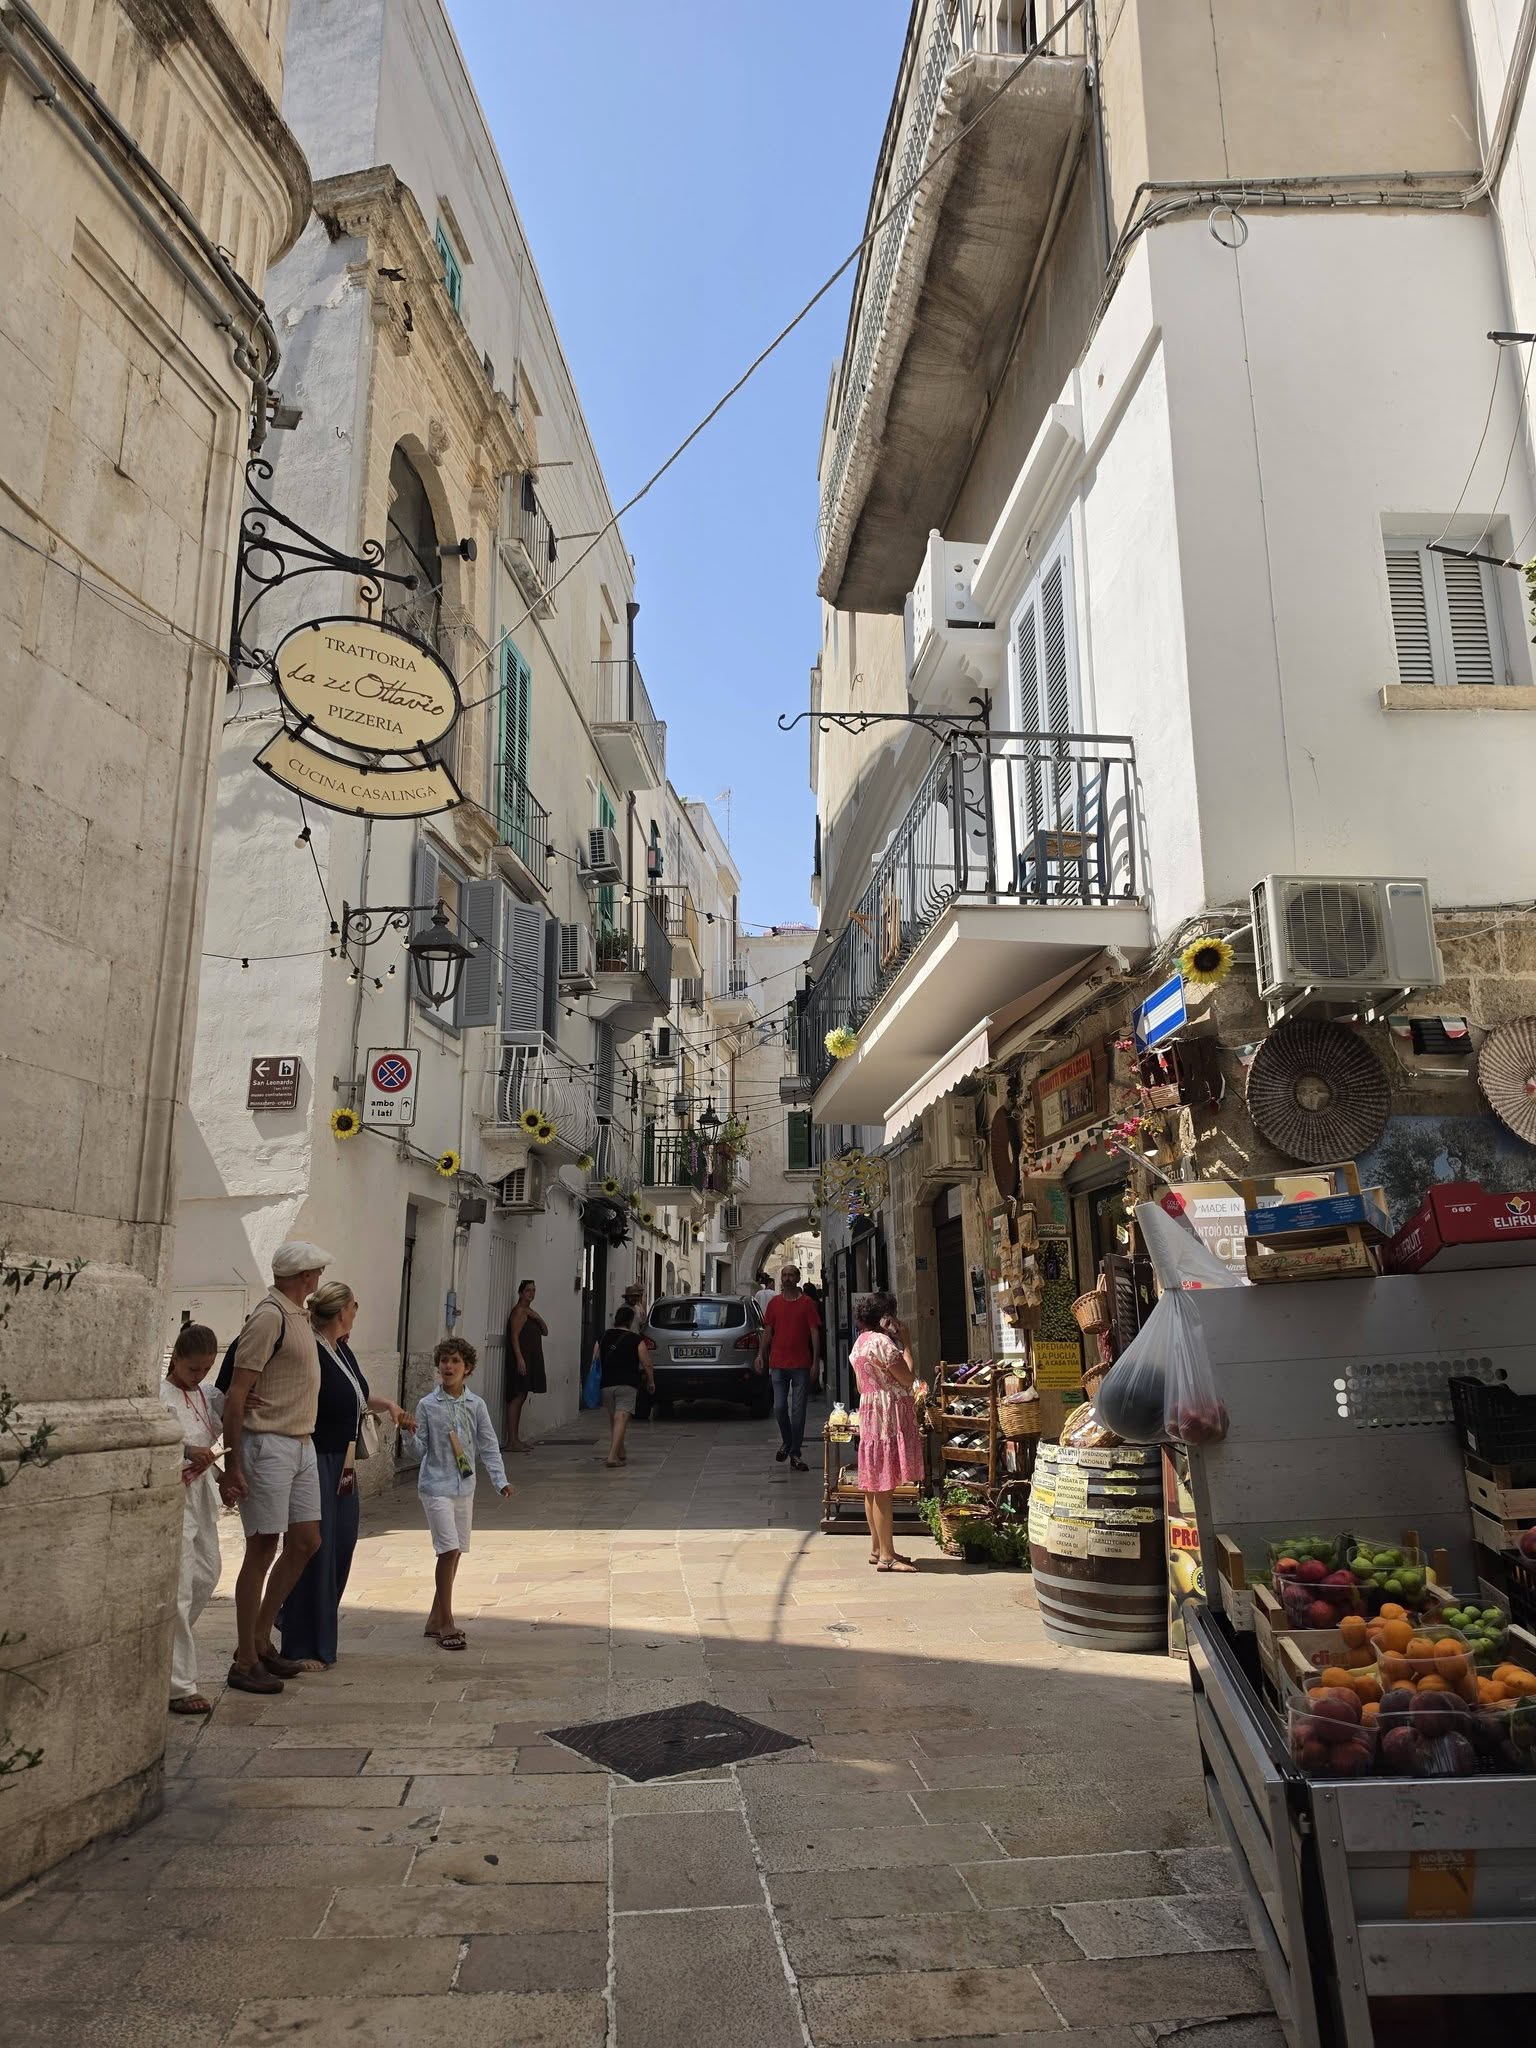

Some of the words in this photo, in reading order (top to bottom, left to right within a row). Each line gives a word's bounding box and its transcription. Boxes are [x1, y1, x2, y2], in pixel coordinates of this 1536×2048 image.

[325, 636, 417, 672] TRATTORIA
[323, 679, 351, 693] zi
[354, 673, 446, 716] Ottavio
[328, 704, 404, 735] PIZZERIA
[288, 758, 348, 794] CUCINA
[351, 785, 438, 801] CASALINGA
[266, 1078, 294, 1086] Leonardo
[371, 1099, 395, 1107] ambo
[371, 1109, 375, 1117] i
[377, 1109, 393, 1117] lati
[1201, 1204, 1227, 1213] MADE
[1230, 1203, 1241, 1212] IN
[1036, 1343, 1078, 1351] SPEDIAMO
[1038, 1352, 1047, 1360] LA
[1048, 1352, 1077, 1360] PUGLIA
[1056, 1493, 1086, 1502] ARTIGIANALE
[1172, 1527, 1200, 1548] PRO
